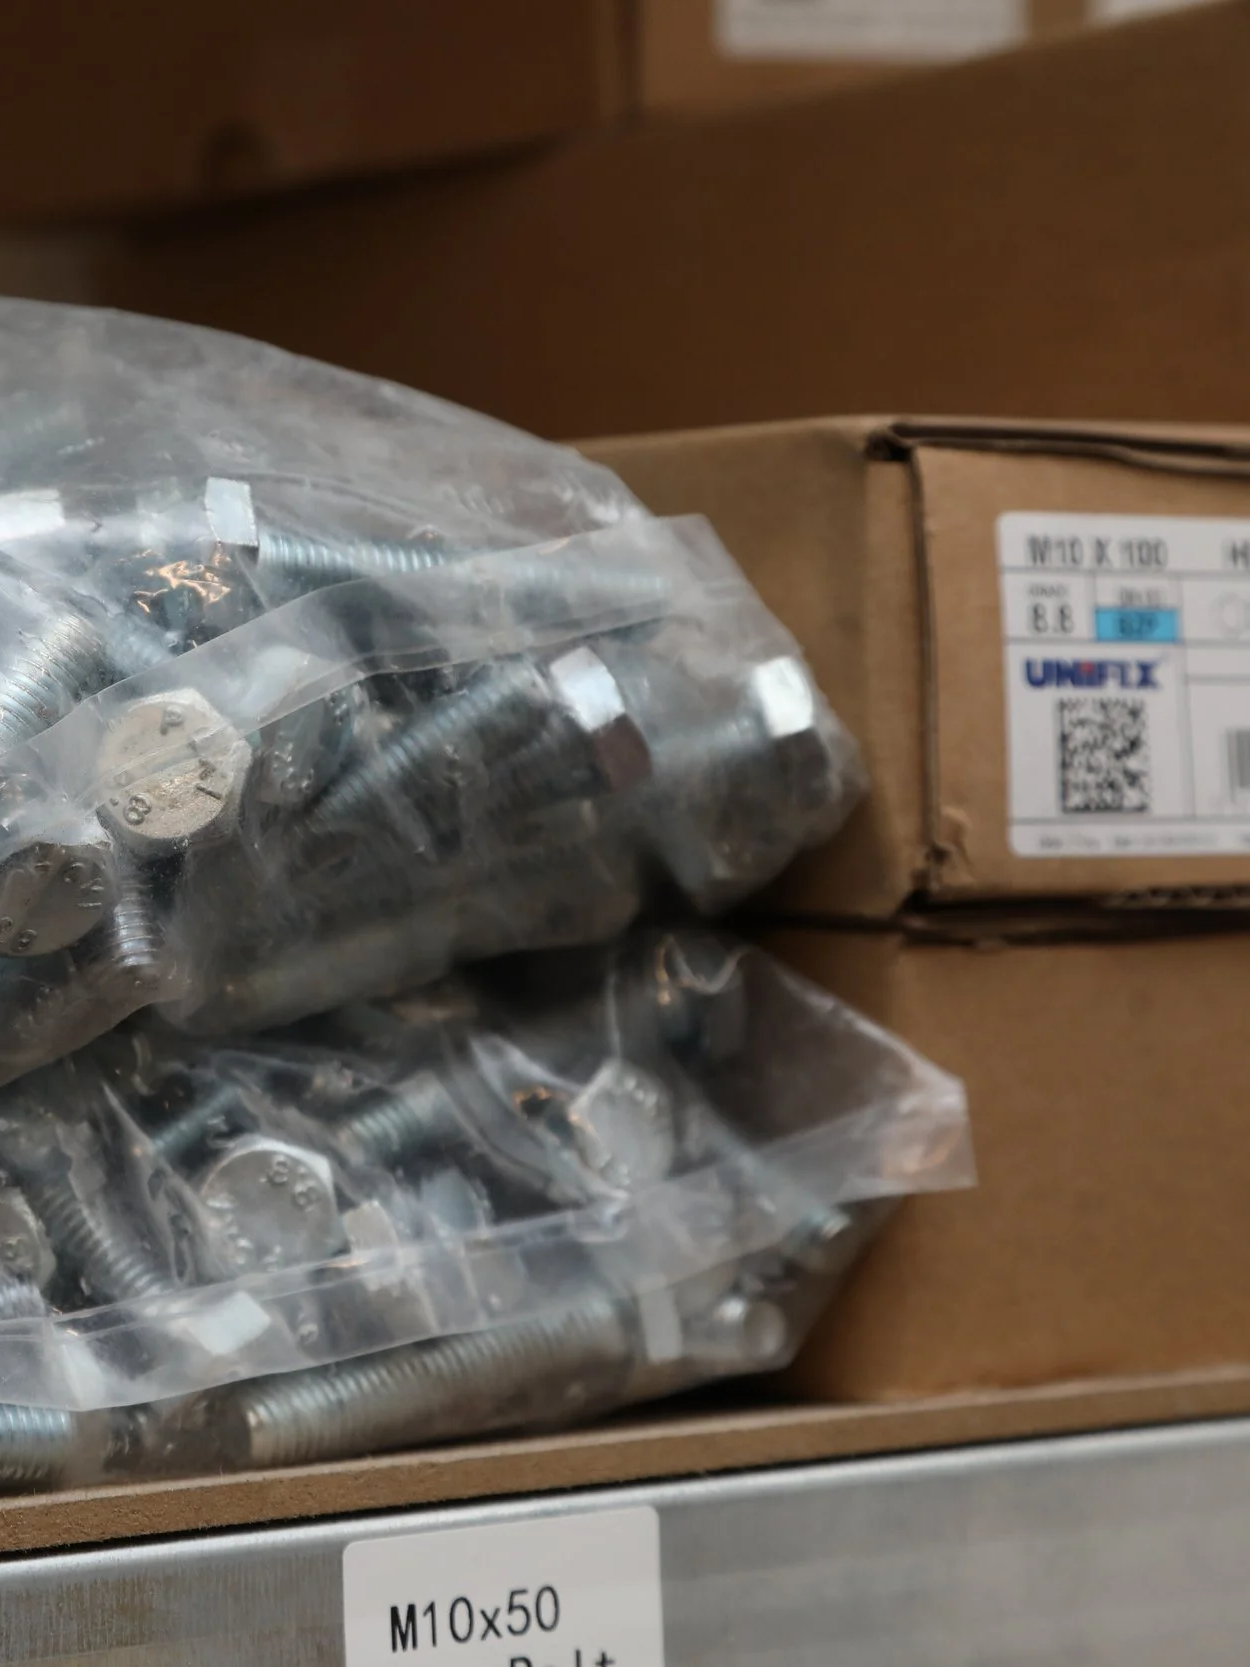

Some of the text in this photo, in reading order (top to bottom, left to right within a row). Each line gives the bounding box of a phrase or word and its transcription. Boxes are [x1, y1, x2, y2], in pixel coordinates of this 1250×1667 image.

[1118, 539, 1168, 570] 100
[1024, 657, 1161, 690] UNIFIX
[390, 1585, 561, 1652] M10x50
